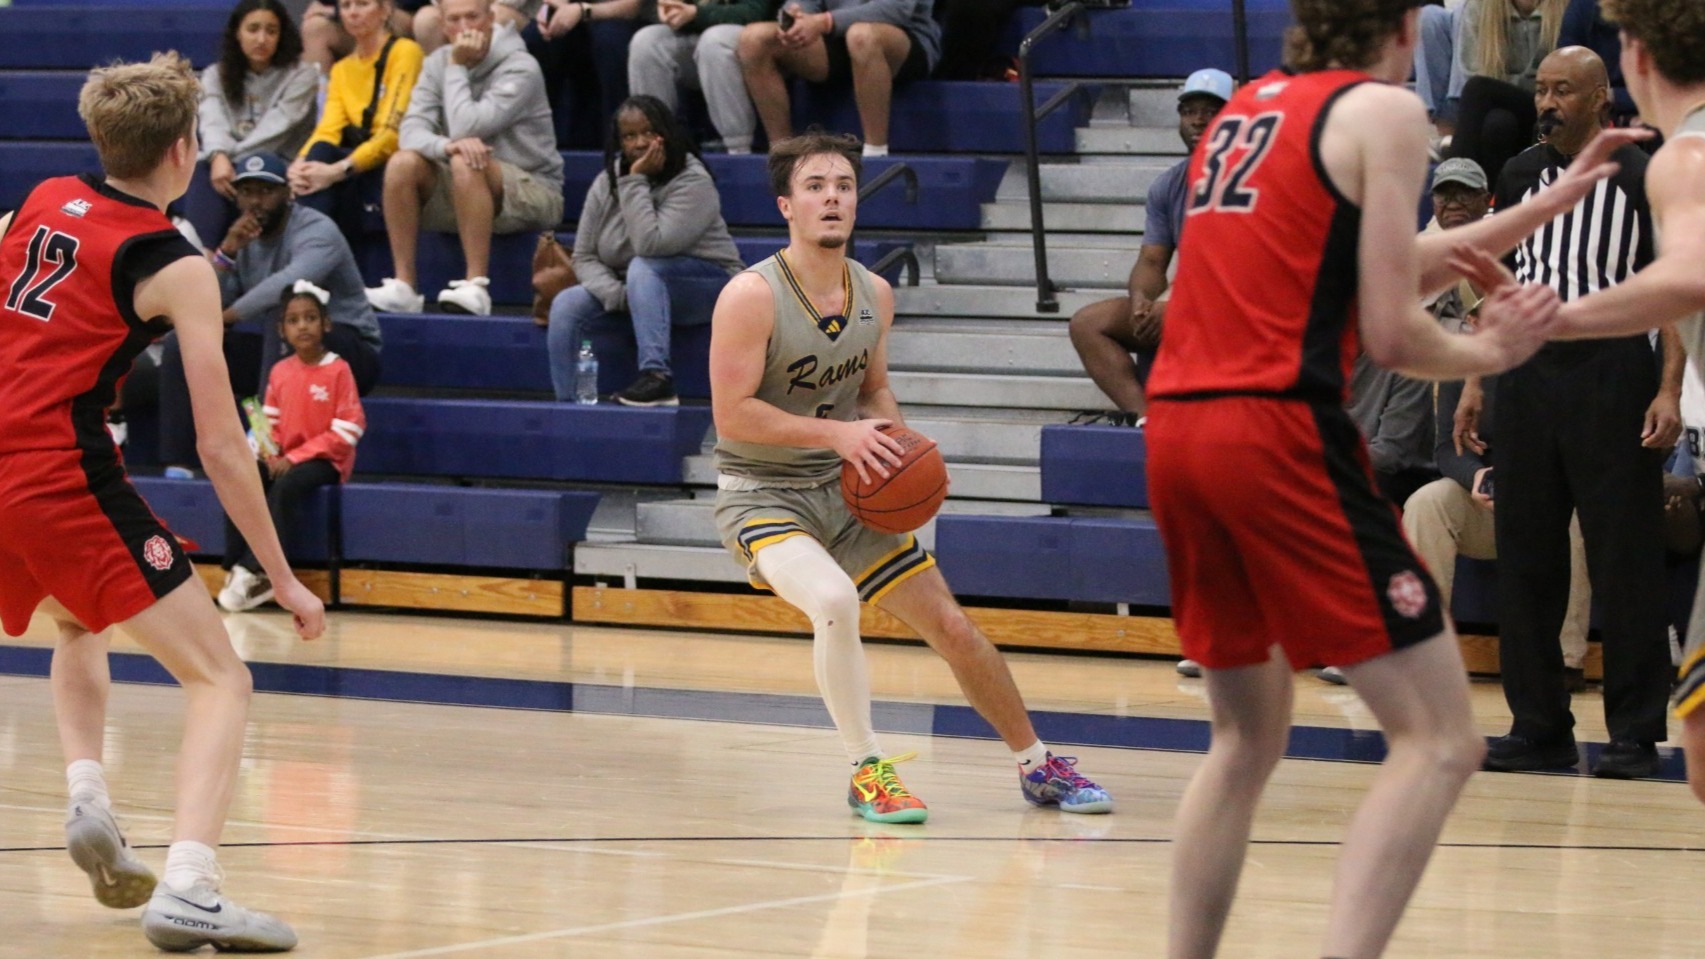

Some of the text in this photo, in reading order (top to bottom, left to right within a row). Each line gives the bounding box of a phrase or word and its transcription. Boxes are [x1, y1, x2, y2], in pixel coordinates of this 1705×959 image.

[1186, 111, 1285, 216] 32
[4, 224, 81, 323] 12
[786, 348, 868, 395] Rams
